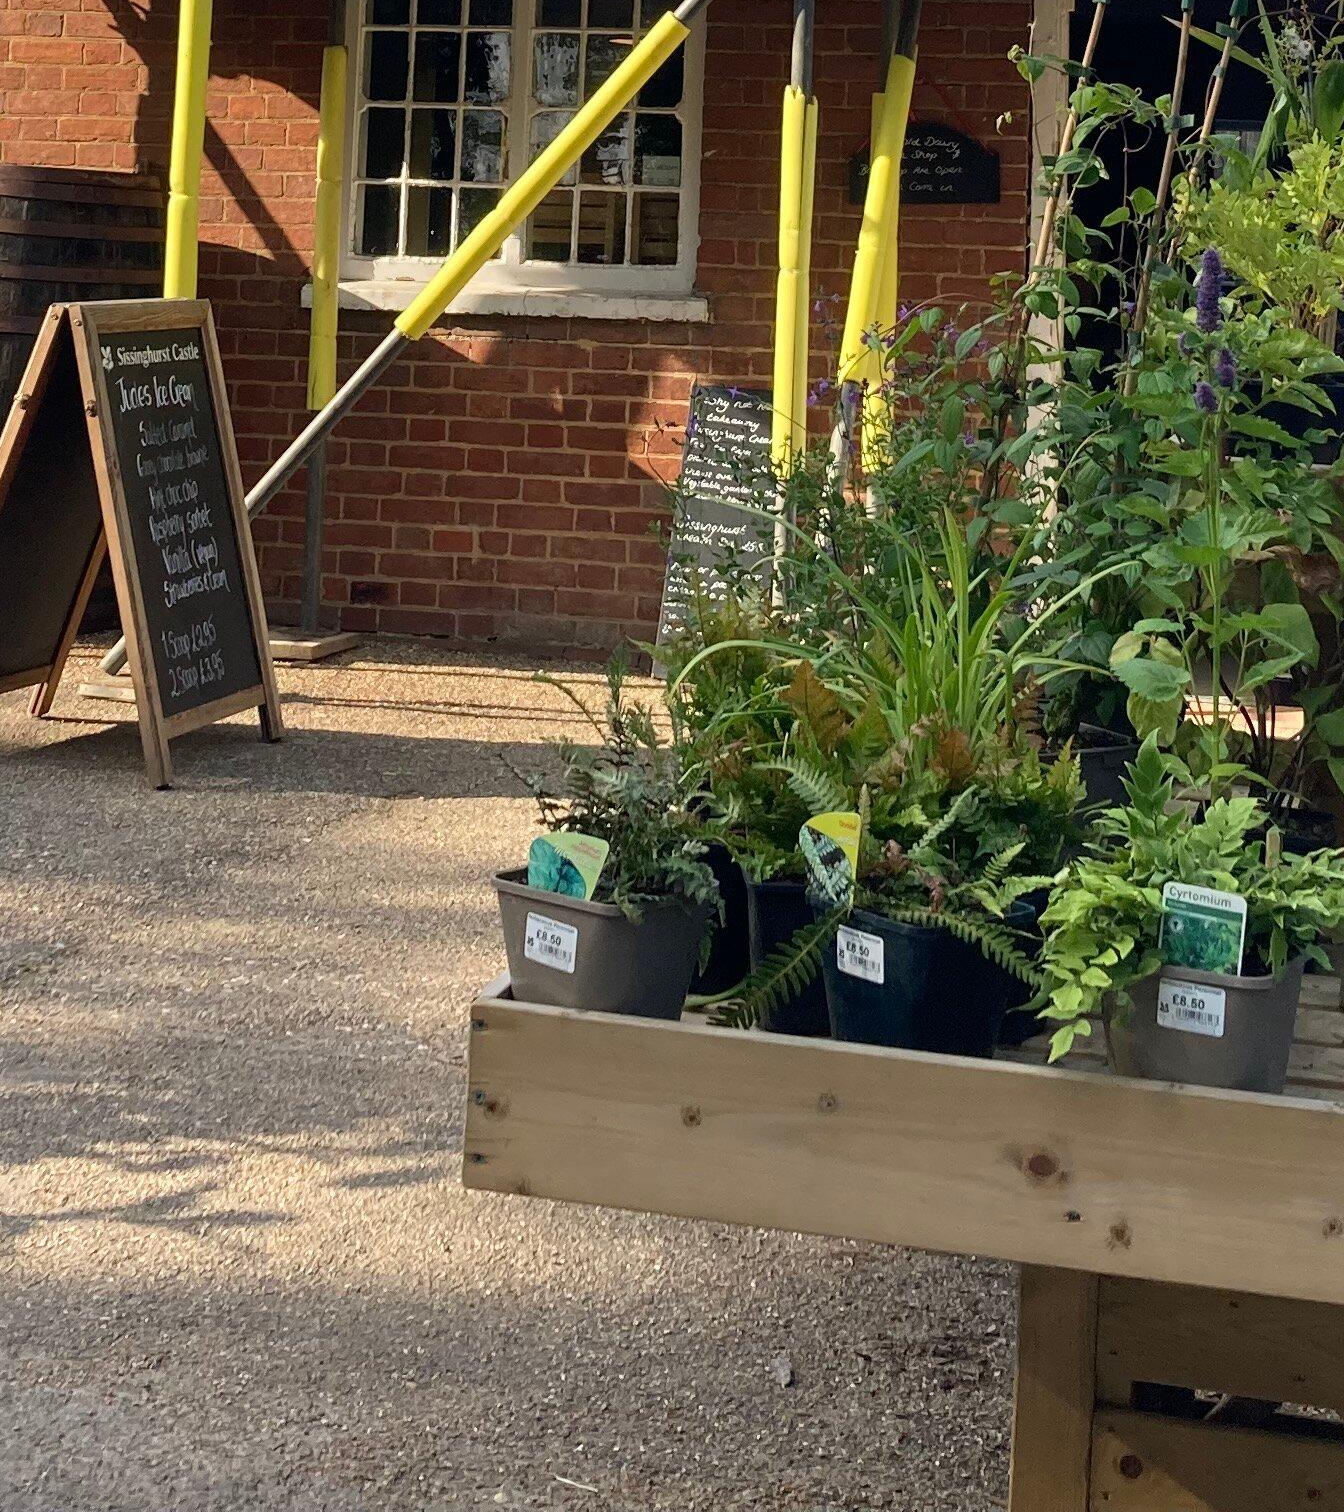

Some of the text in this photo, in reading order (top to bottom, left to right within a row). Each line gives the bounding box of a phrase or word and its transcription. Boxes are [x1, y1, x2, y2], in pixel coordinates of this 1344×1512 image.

[116, 342, 200, 368] Sissinghurst Castle
[152, 375, 170, 408] Ice
[1168, 885, 1233, 909] Cyrtomium
